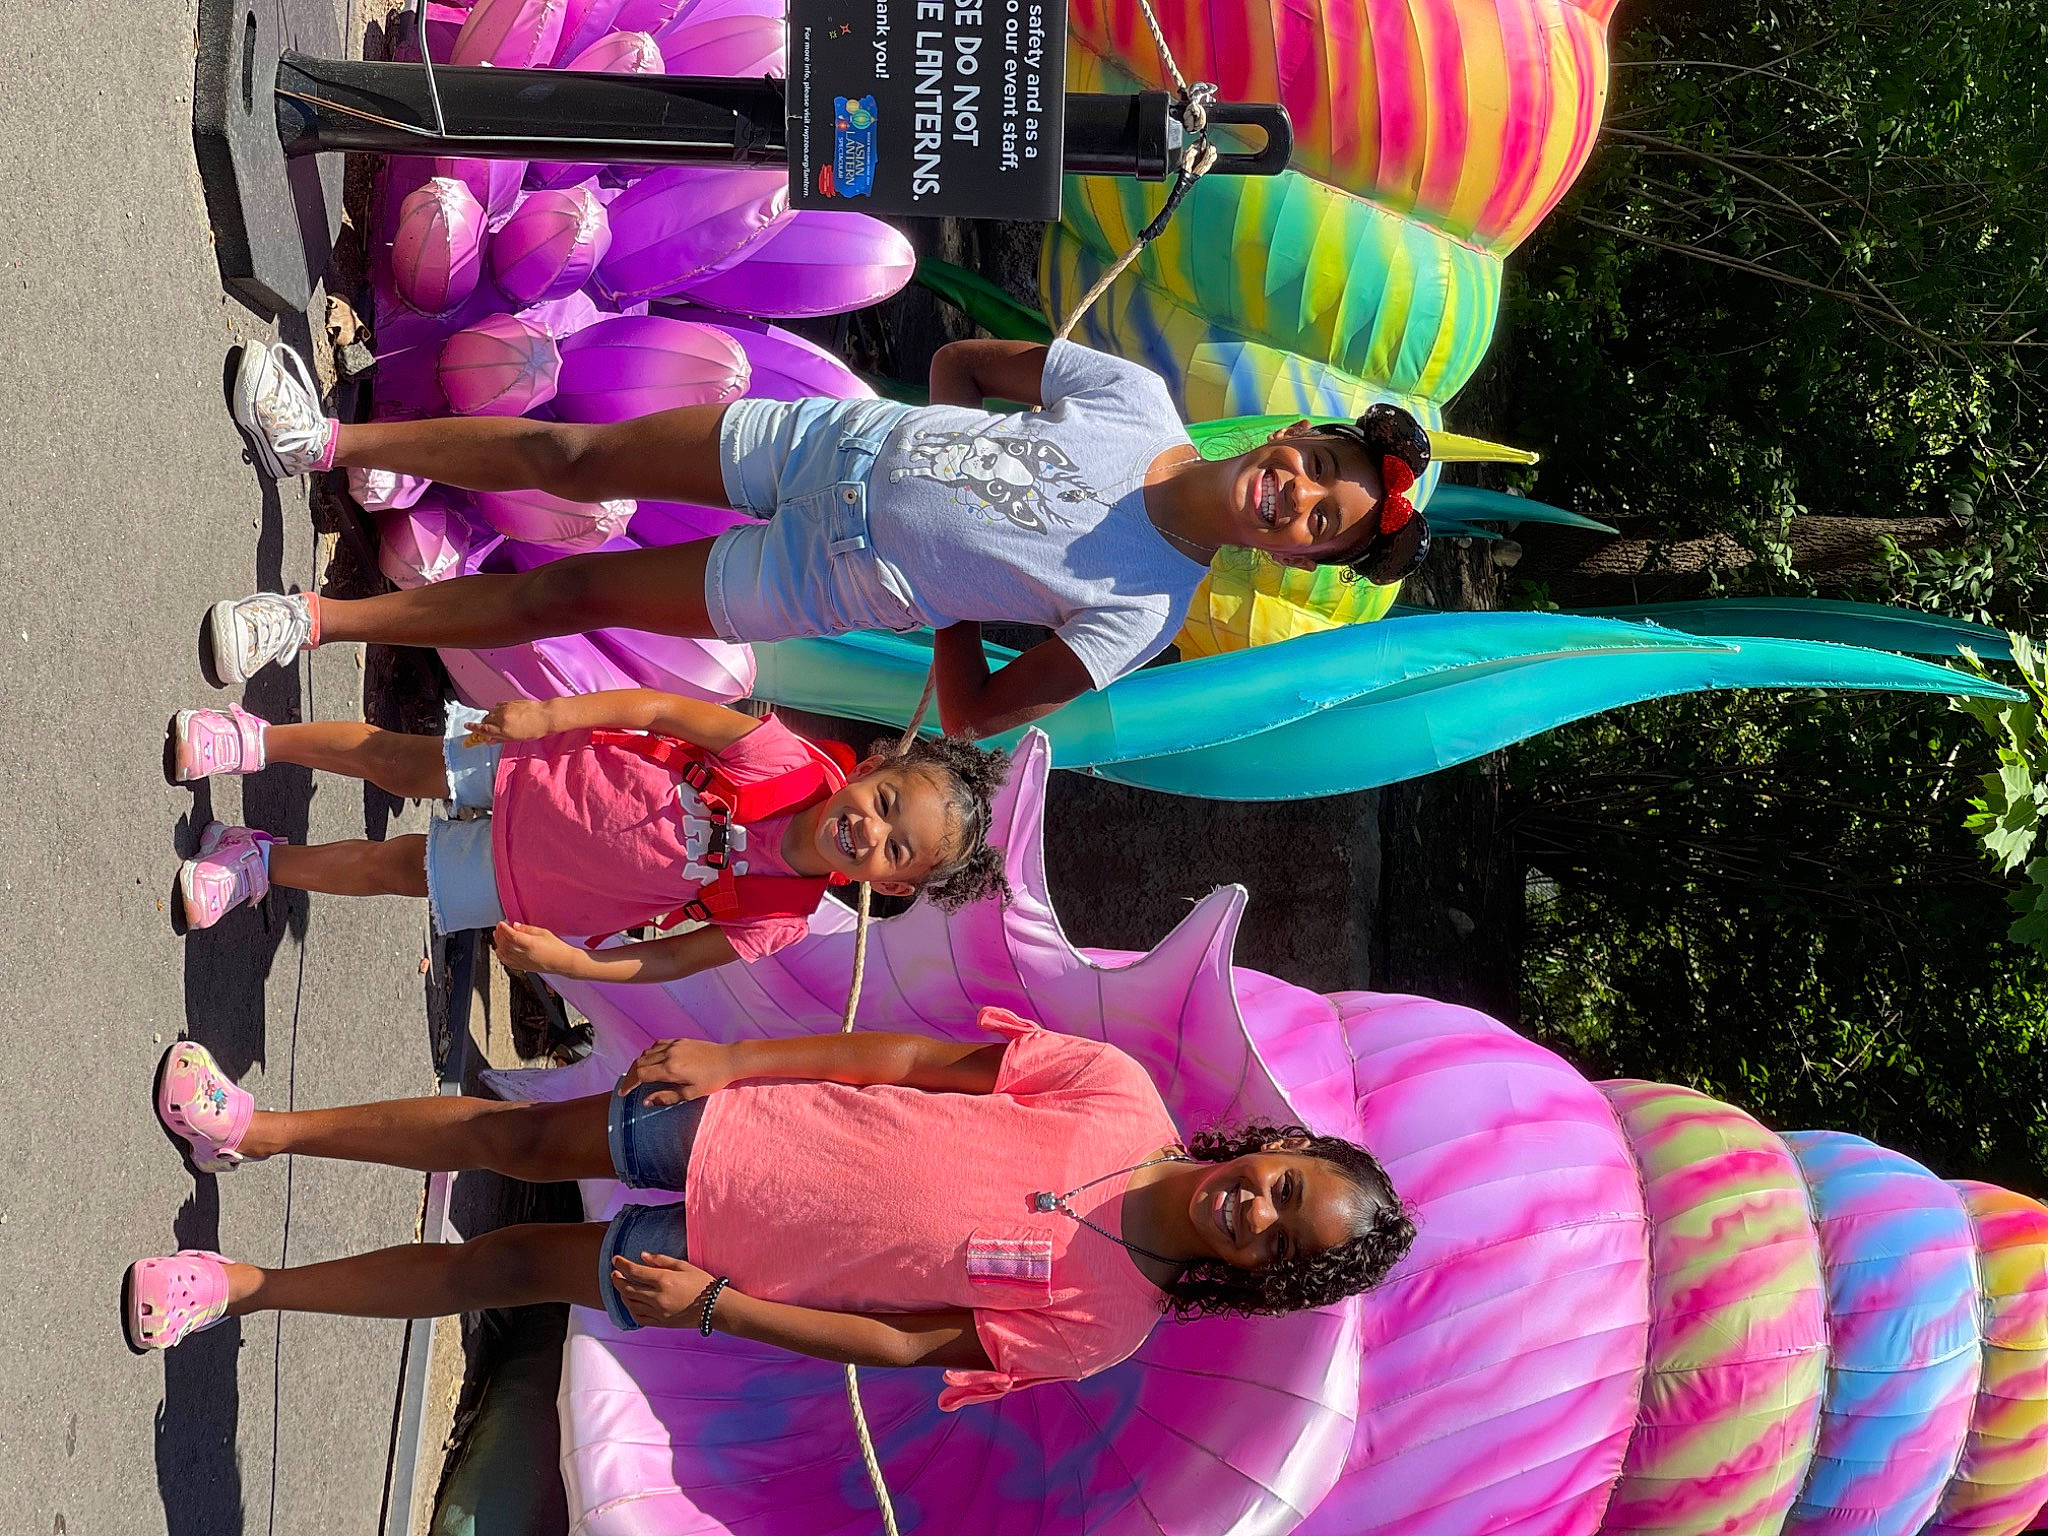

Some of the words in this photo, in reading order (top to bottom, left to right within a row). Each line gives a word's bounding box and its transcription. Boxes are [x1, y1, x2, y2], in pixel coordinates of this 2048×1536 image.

[916, 0, 944, 21] E
[804, 27, 812, 40] For
[1005, 18, 1019, 54] our
[1023, 4, 1045, 68] safety
[803, 63, 812, 81] info,
[872, 41, 890, 79] you!
[953, 37, 982, 75] DO
[802, 82, 811, 107] please
[1003, 59, 1019, 117] event
[1026, 73, 1043, 112] and
[803, 108, 811, 124] visit
[912, 31, 944, 201] LANTERNS.
[952, 85, 981, 147] NOT
[1025, 118, 1039, 141] as
[845, 131, 855, 186] LANTERN
[855, 141, 865, 176] ASIAN
[999, 122, 1019, 172] staff,
[1024, 146, 1038, 158] a
